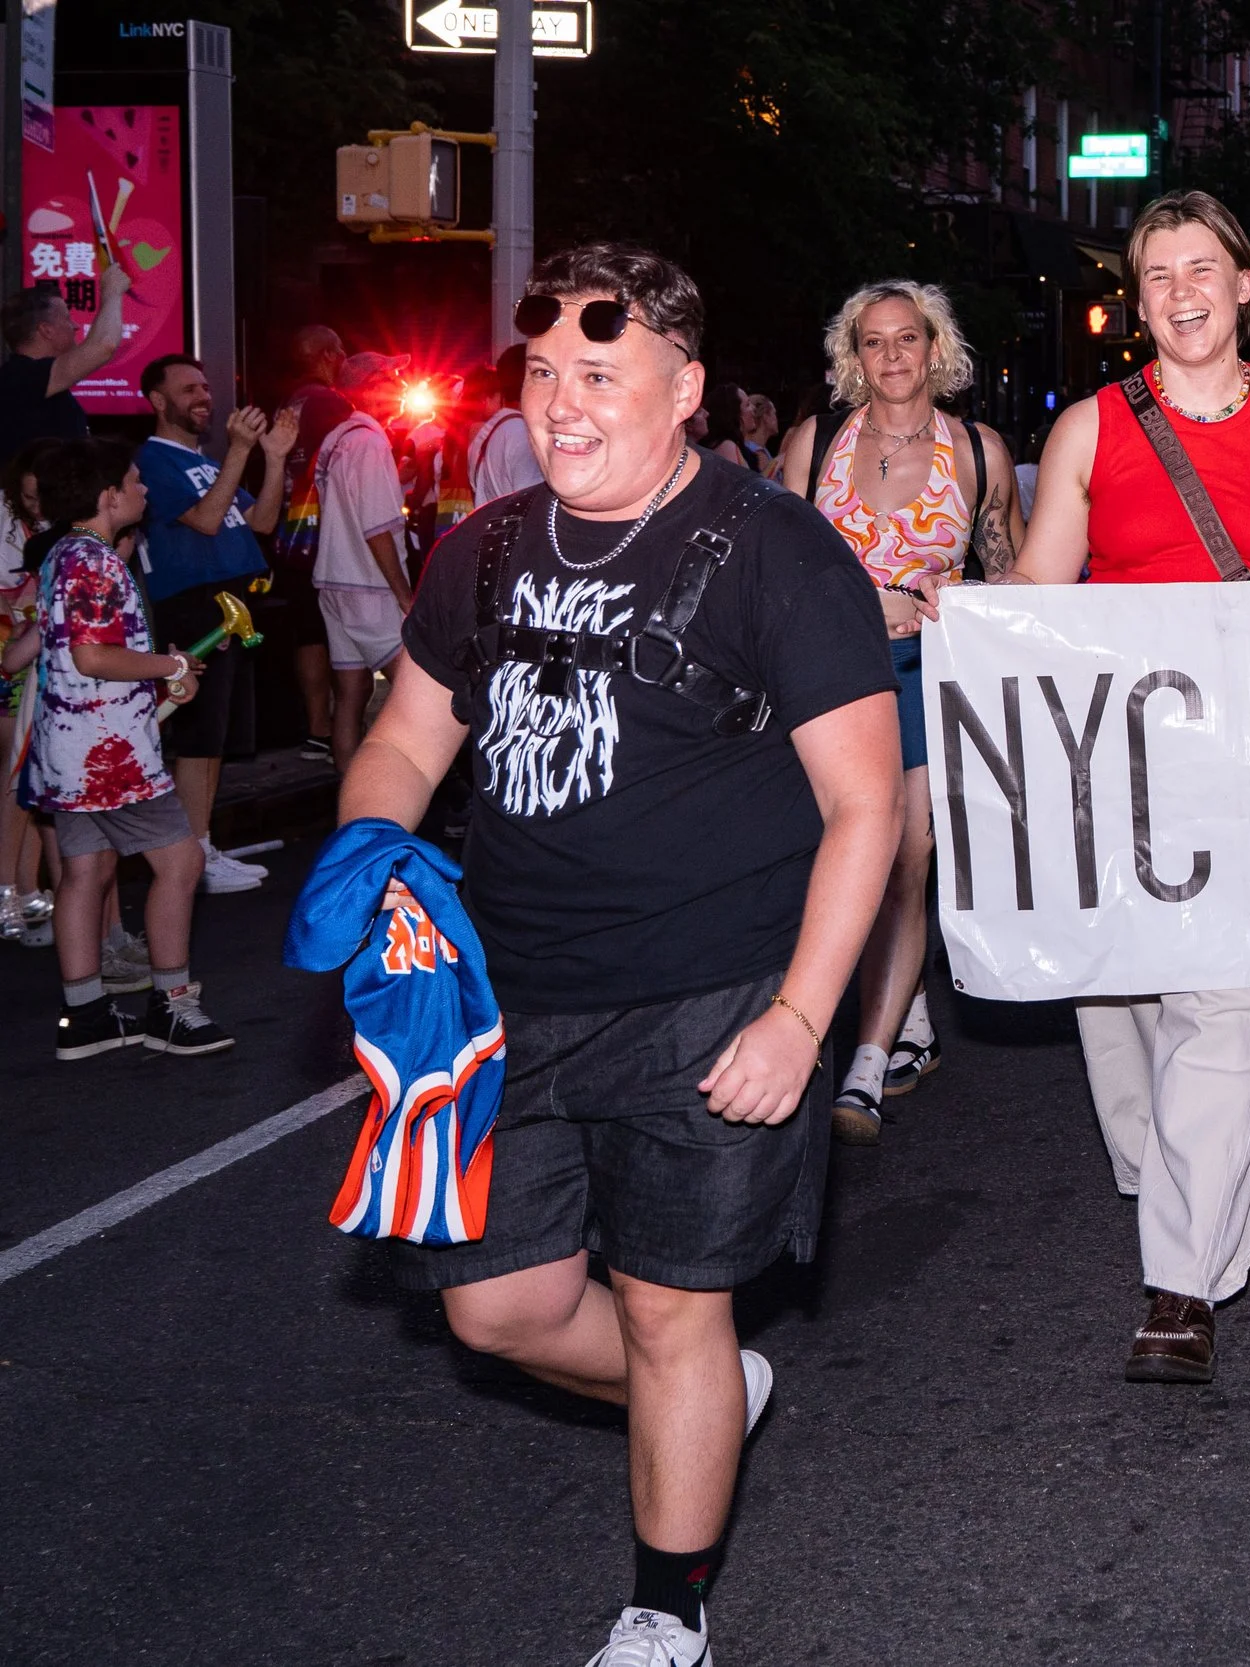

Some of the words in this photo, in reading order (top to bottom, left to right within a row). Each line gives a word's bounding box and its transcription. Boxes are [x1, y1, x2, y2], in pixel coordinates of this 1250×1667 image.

[119, 22, 185, 38] LinkNYC
[444, 12, 495, 33] ONE
[532, 17, 563, 36] AY
[30, 242, 96, 277] 免費
[938, 668, 1212, 912] NYC
[638, 1611, 657, 1620] NIKE
[645, 1621, 658, 1629] AIR
